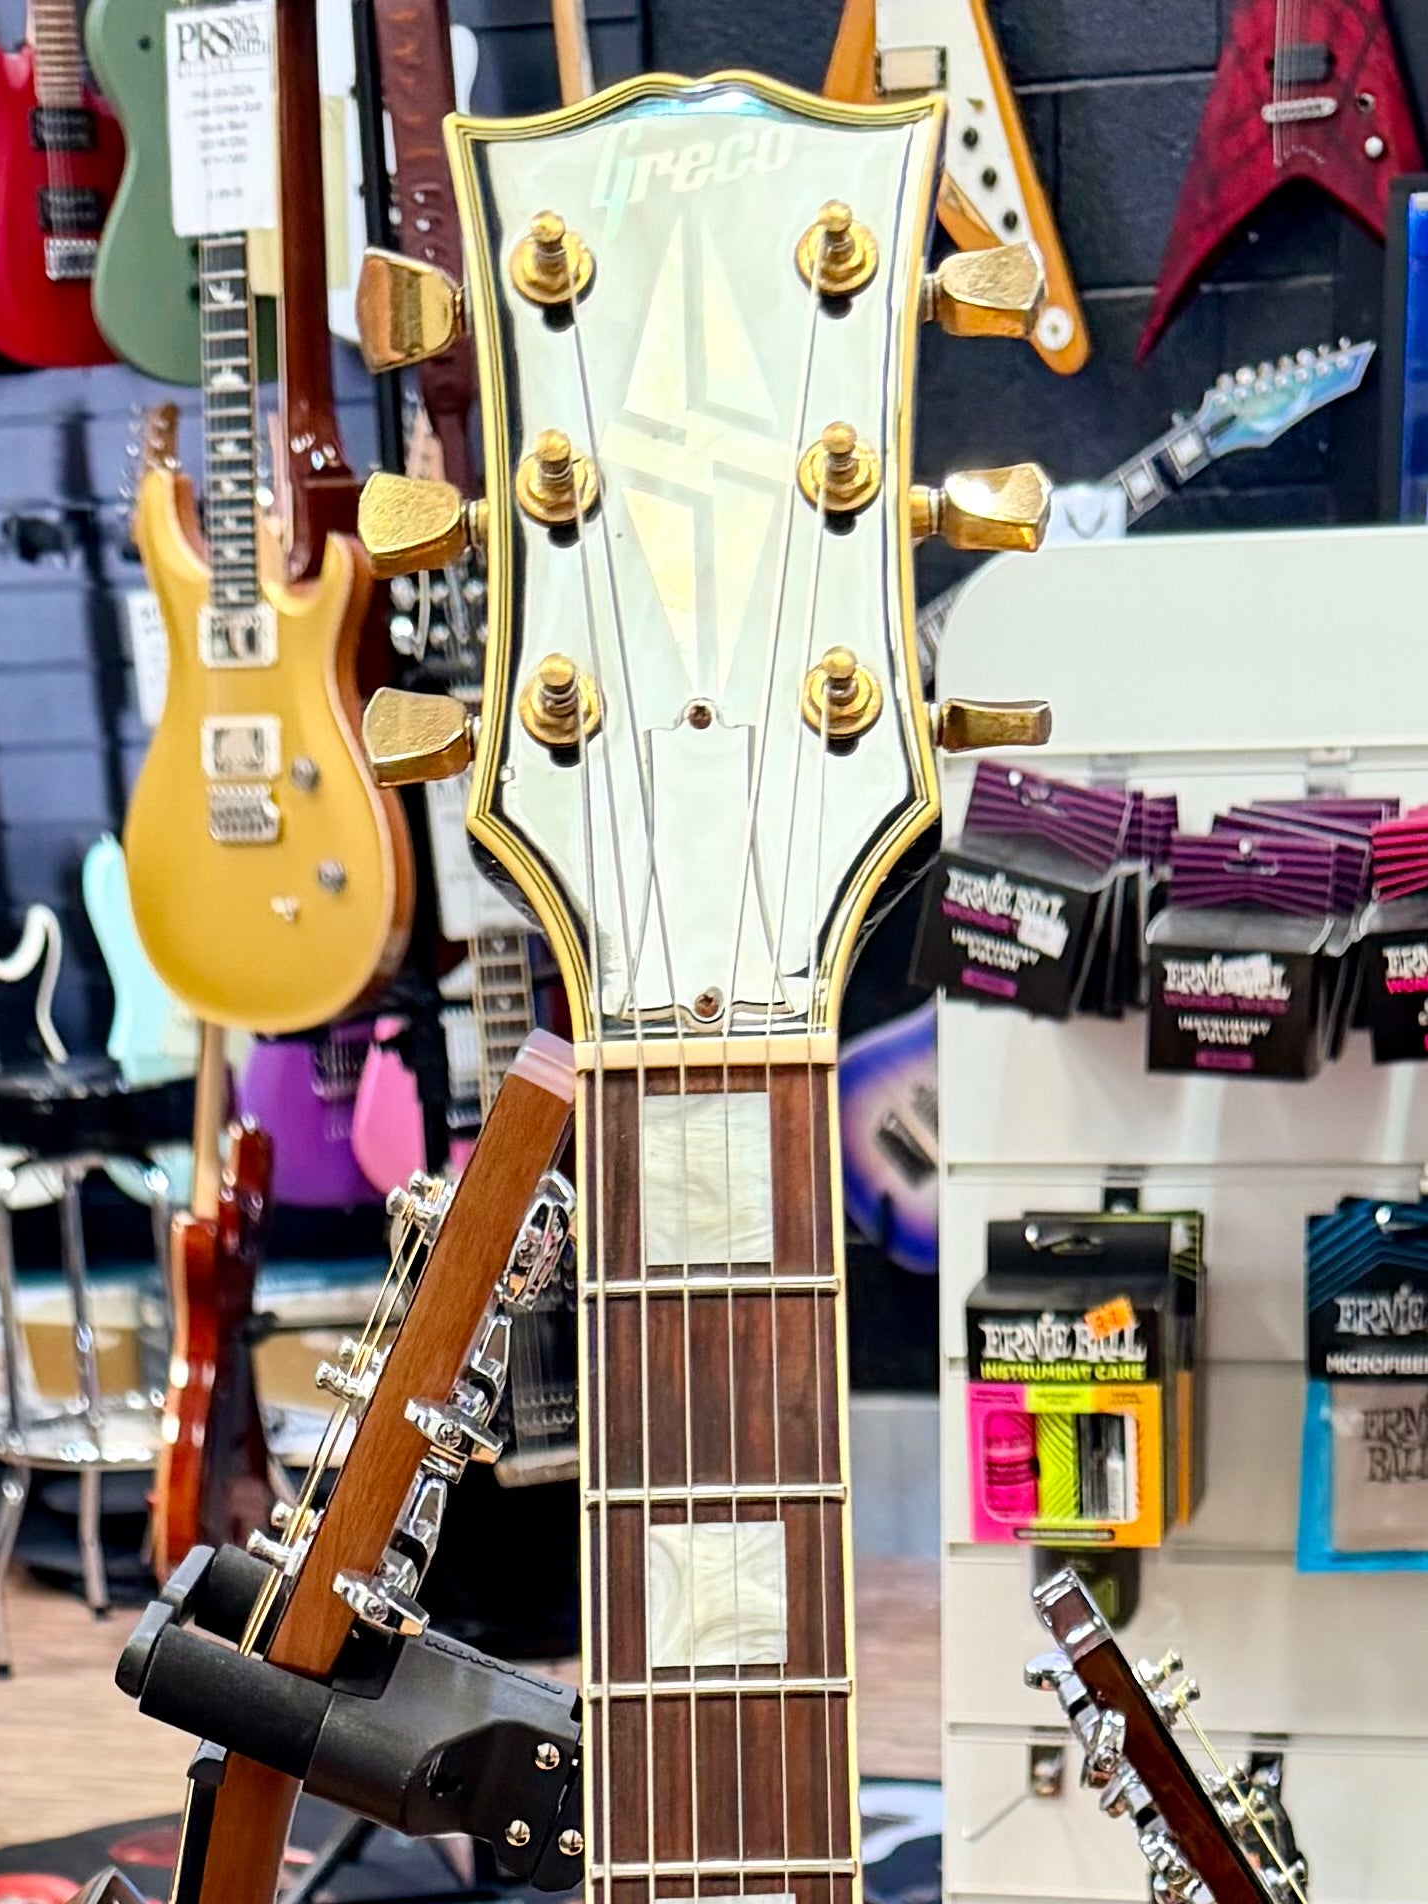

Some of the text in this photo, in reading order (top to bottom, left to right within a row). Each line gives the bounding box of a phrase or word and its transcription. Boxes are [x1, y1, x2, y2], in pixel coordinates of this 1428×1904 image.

[177, 18, 235, 63] PRS
[590, 122, 795, 241] Greco
[979, 1311, 1072, 1363] ERNIE
[1335, 1285, 1427, 1337] ERNIE
[980, 1361, 1148, 1382] INSTRUMENT CARE
